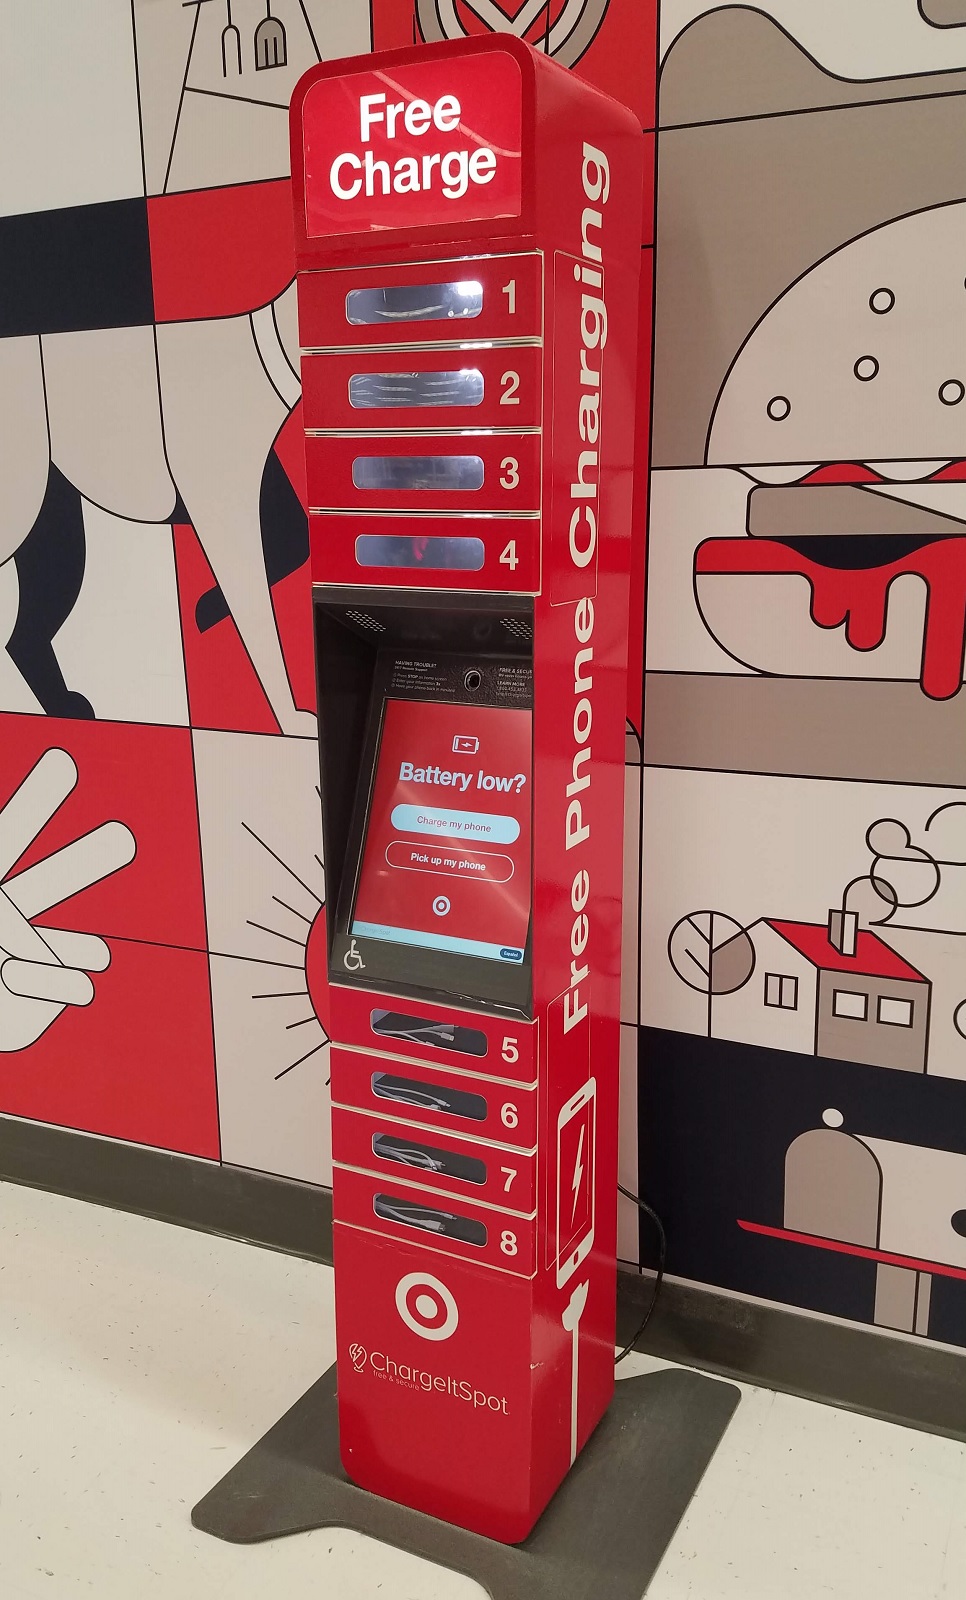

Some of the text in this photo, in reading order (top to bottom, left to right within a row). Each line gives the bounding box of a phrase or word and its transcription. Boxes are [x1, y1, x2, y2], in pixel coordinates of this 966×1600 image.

[360, 92, 460, 142] Free
[329, 147, 497, 200] Charge
[502, 280, 516, 314] 1
[500, 370, 520, 405] 2
[499, 457, 520, 489] 3
[499, 540, 519, 570] 4
[563, 141, 610, 1035] Free Phone Charging
[399, 761, 527, 793] Battery low?
[416, 815, 491, 833] Charge my phone
[410, 852, 486, 872] Pick up my phone
[501, 1037, 519, 1064] 5
[500, 1102, 519, 1129] 6
[500, 1167, 518, 1193] 7
[500, 1230, 518, 1256] 8
[370, 1351, 509, 1415] ChargeItSpot
[372, 1369, 420, 1391] free & secure
